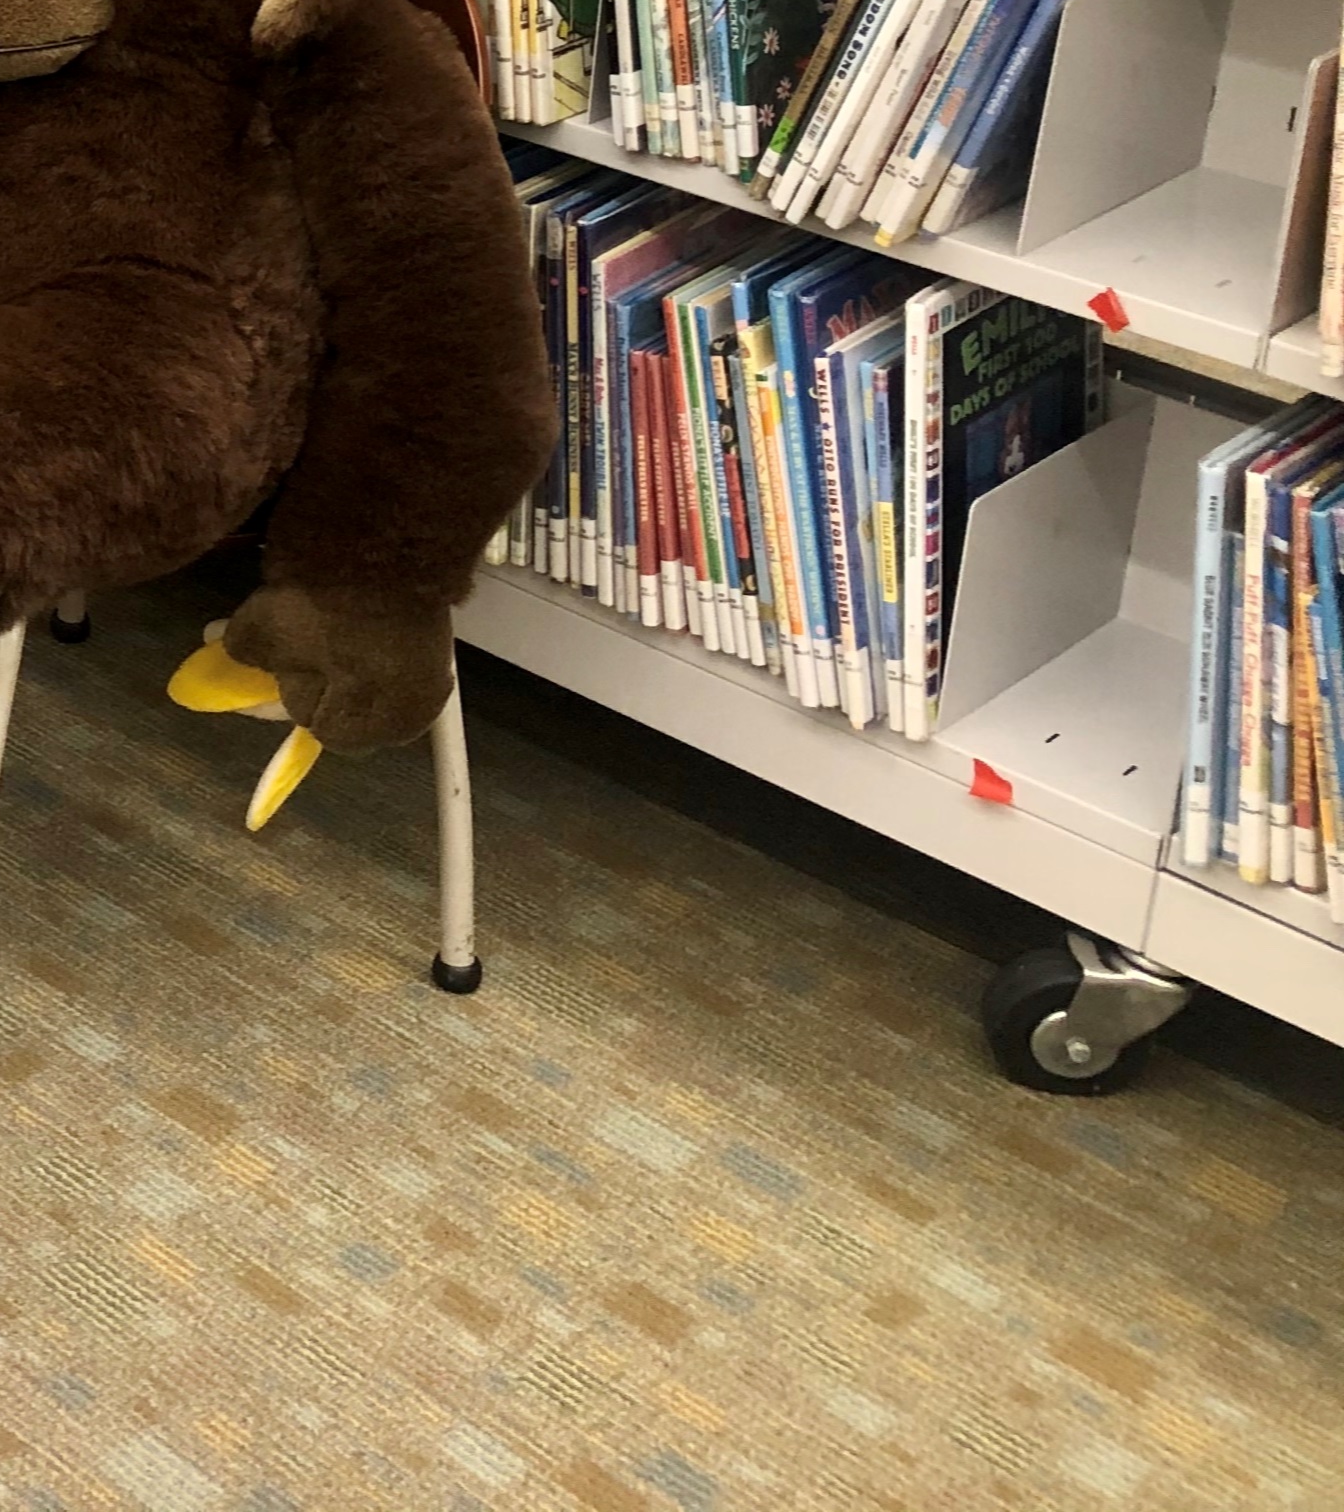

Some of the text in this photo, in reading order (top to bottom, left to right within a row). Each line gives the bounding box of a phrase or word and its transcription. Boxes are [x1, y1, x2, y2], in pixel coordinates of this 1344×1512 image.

[836, 38, 866, 83] SONG
[950, 335, 1080, 426] DAYS OF SCHOOL
[978, 321, 1059, 383] FIRST 100
[816, 369, 850, 625] WELLS OTTO RUNS FOR PRESIDENT
